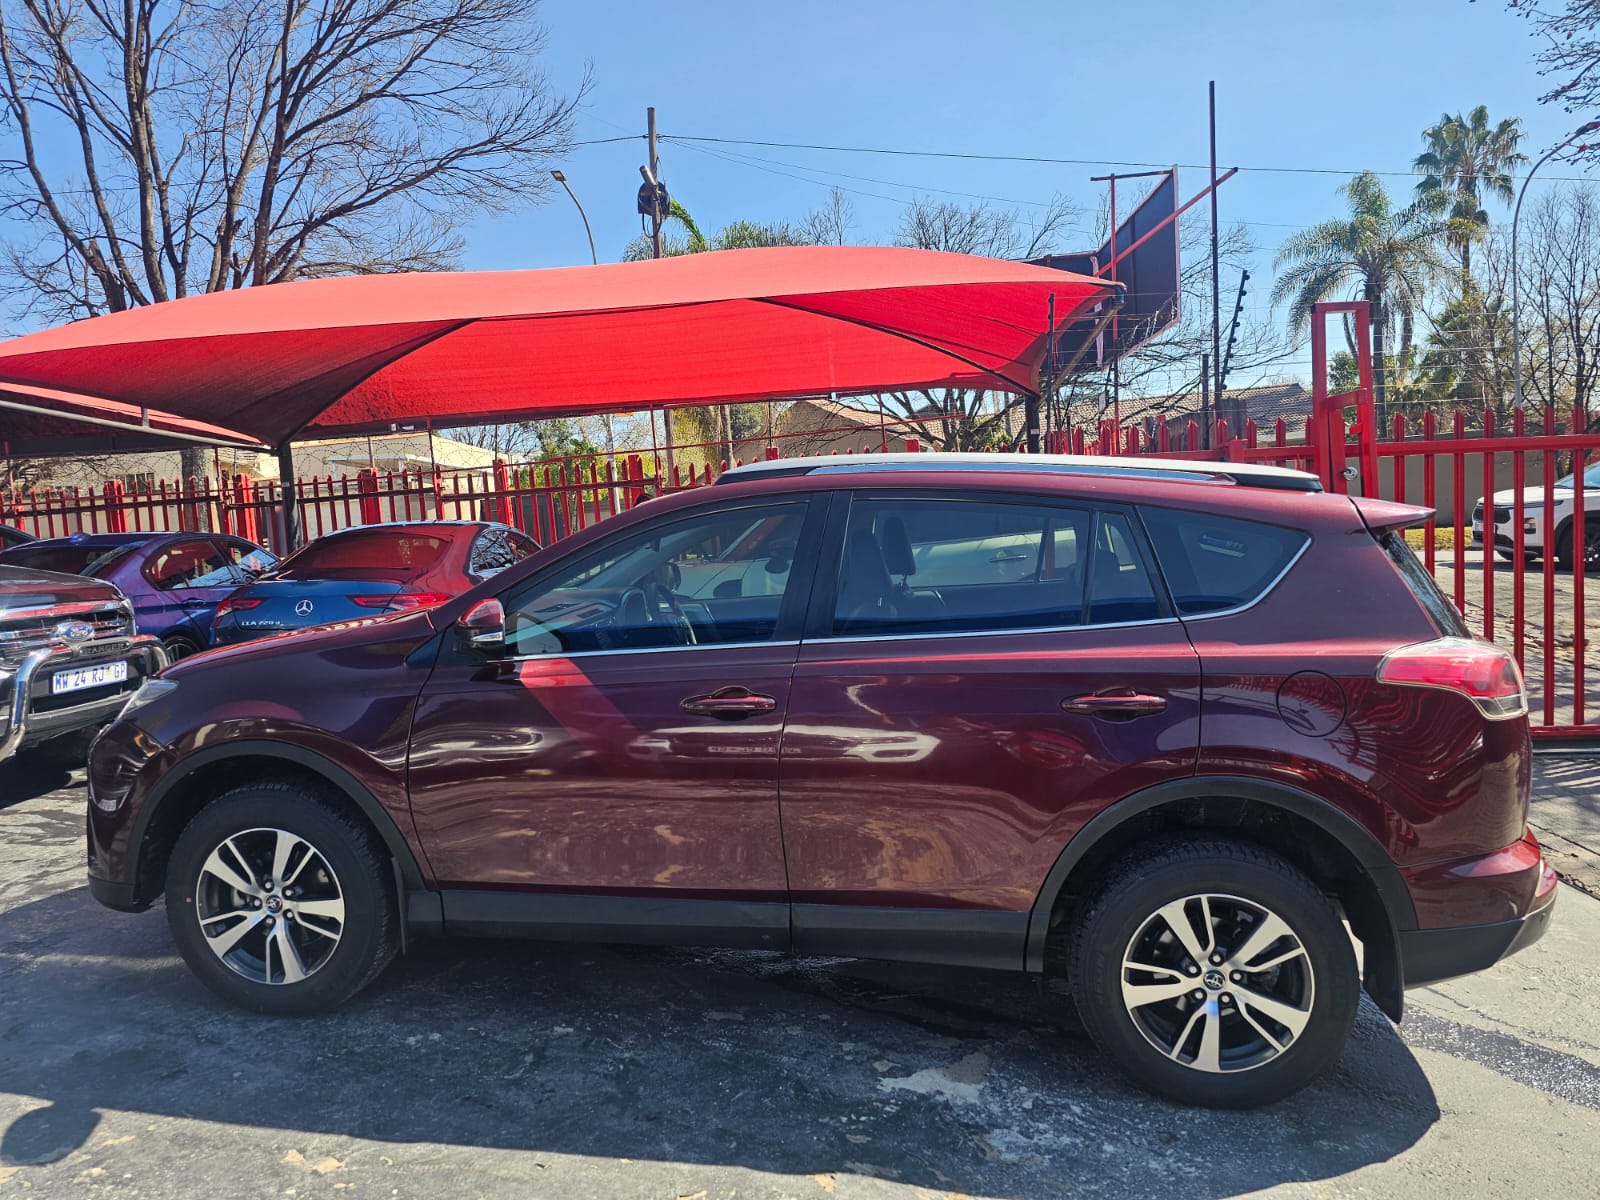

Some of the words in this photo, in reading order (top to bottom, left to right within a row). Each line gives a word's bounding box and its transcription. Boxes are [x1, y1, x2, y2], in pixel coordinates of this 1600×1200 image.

[74, 670, 87, 686] 24
[92, 666, 105, 683] RJ
[114, 663, 126, 678] GP
